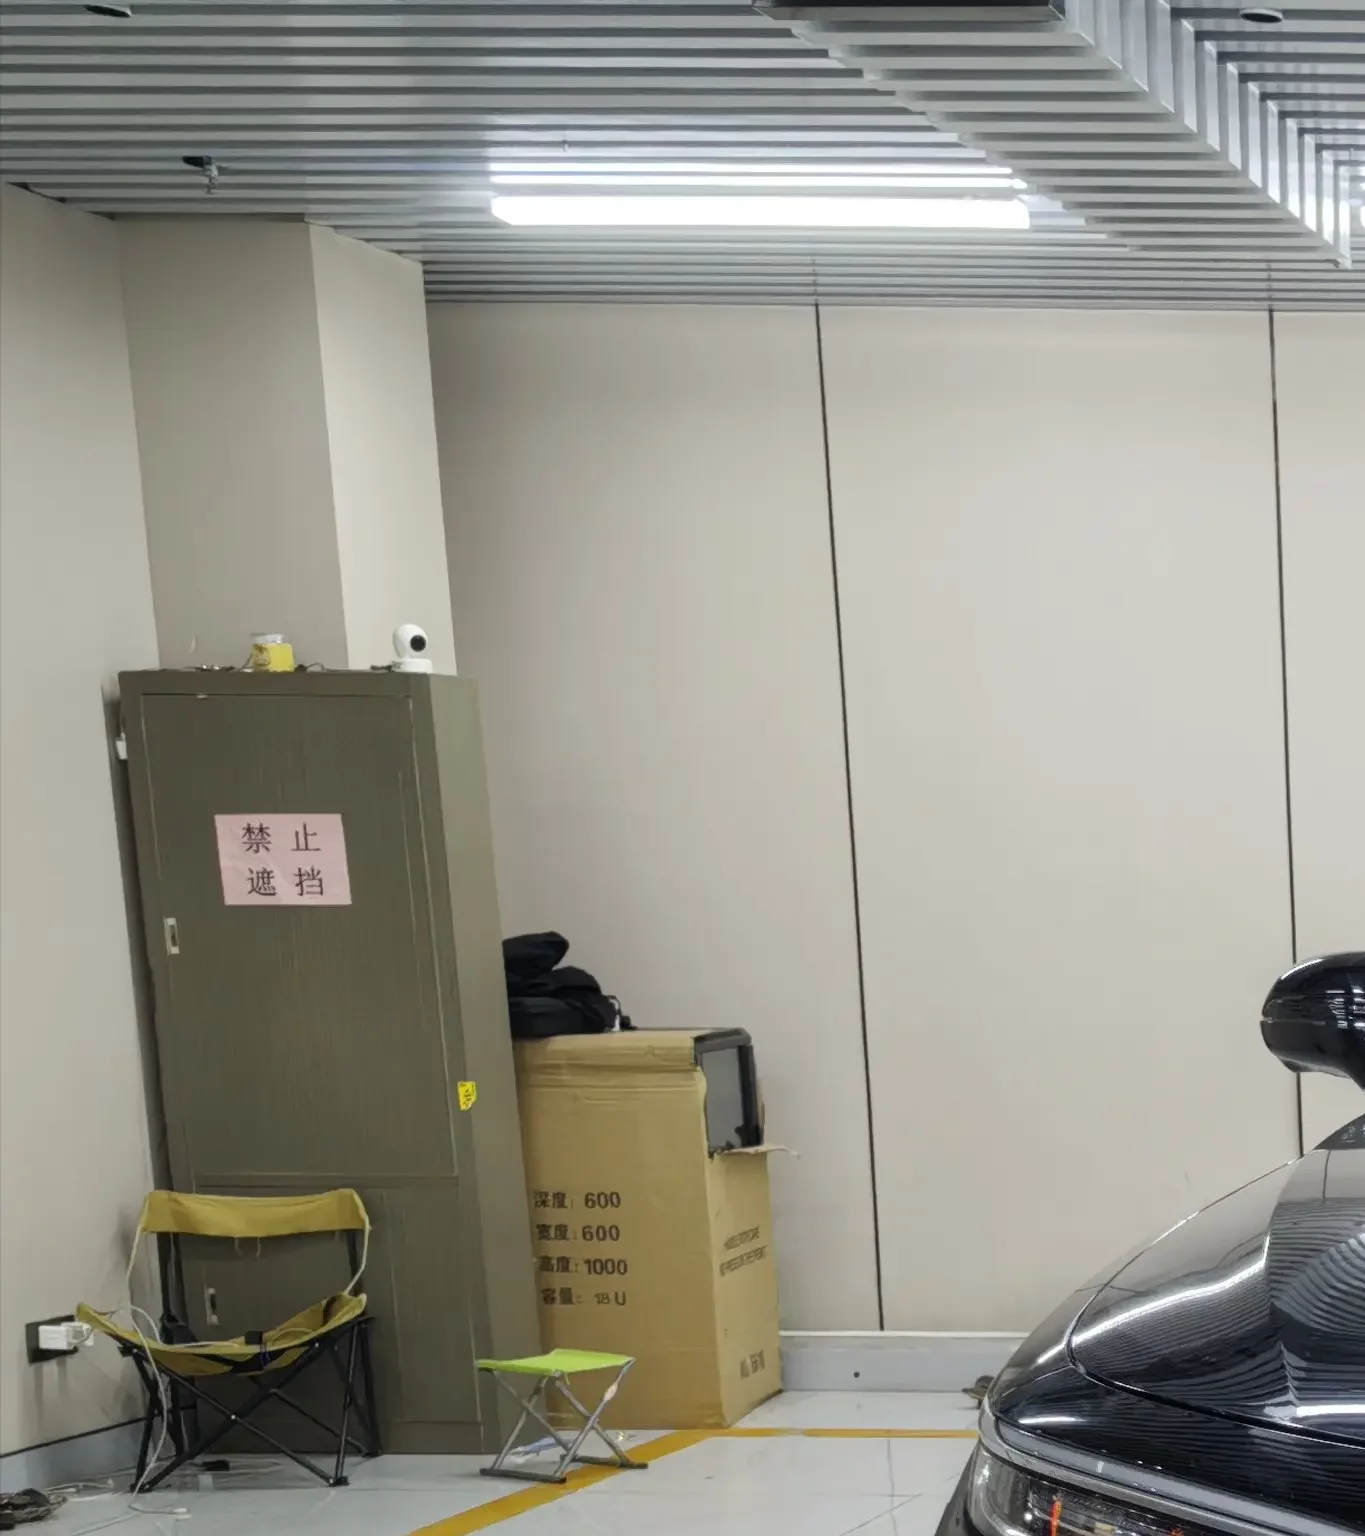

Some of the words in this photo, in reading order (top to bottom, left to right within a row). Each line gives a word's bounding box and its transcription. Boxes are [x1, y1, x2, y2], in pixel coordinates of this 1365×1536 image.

[241, 821, 322, 854] 禁止
[247, 866, 324, 896] 遮挡
[584, 1191, 622, 1209] 600
[582, 1224, 620, 1242] 600
[583, 1258, 628, 1275] 1000
